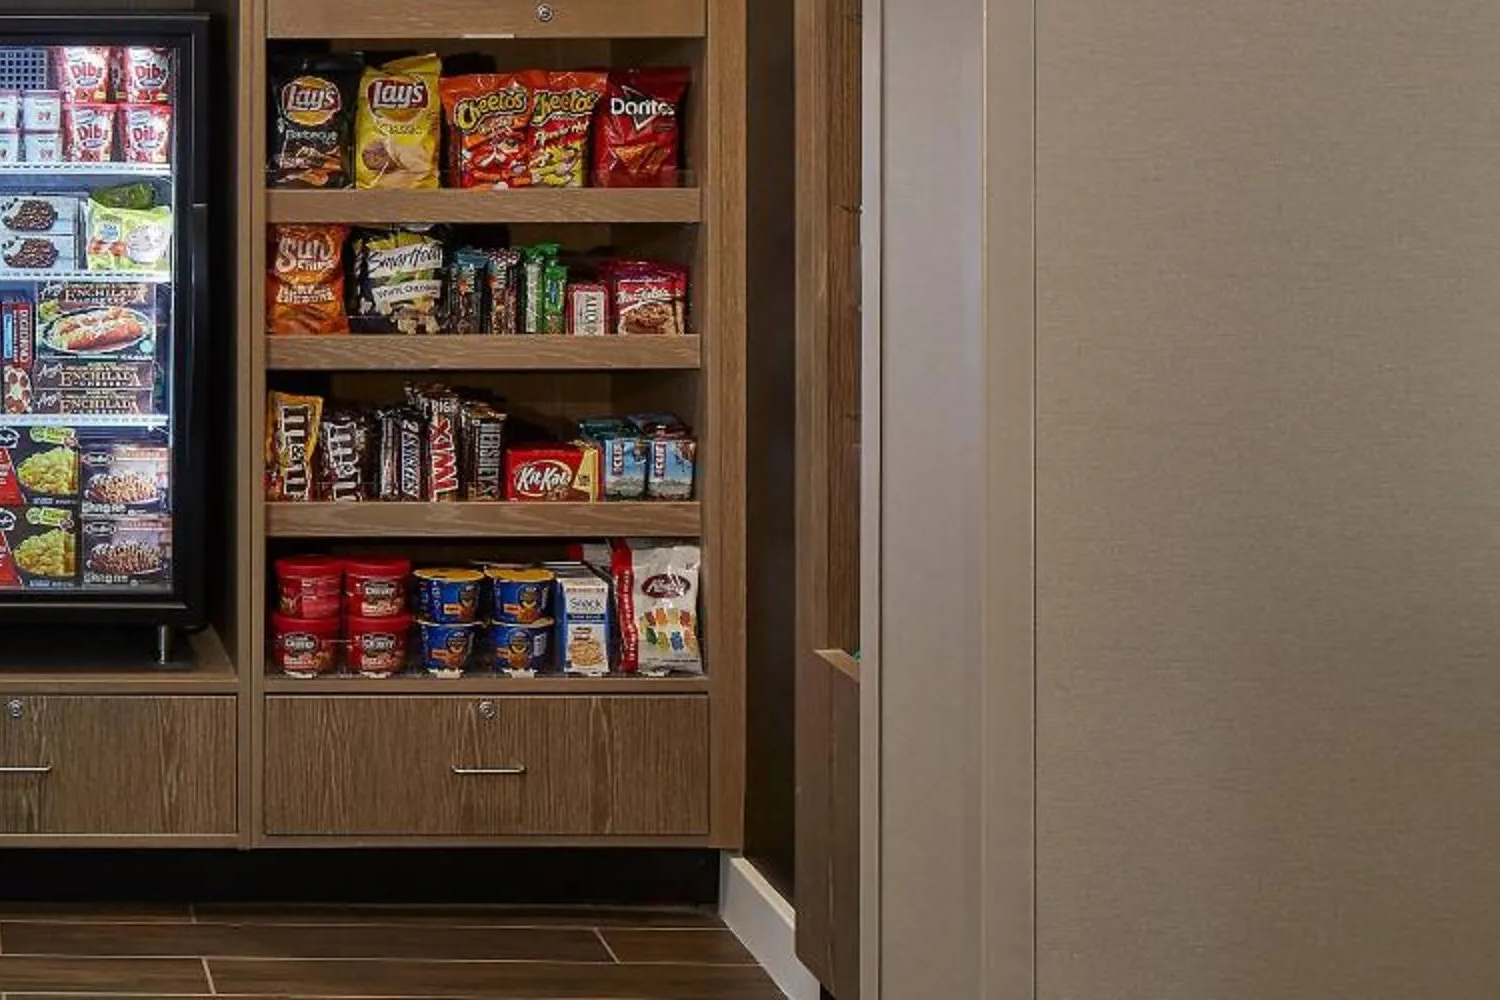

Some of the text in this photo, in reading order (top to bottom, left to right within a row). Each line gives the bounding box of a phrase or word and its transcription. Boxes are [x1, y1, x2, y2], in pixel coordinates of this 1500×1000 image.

[71, 62, 104, 80] Dibs
[285, 83, 338, 112] Lay's
[371, 80, 425, 109] Lay's
[456, 88, 526, 130] Cheetos
[610, 97, 676, 116] Doritos
[76, 125, 110, 143] Dibs
[132, 126, 166, 143] Dibs
[59, 370, 143, 388] ENCHILADA
